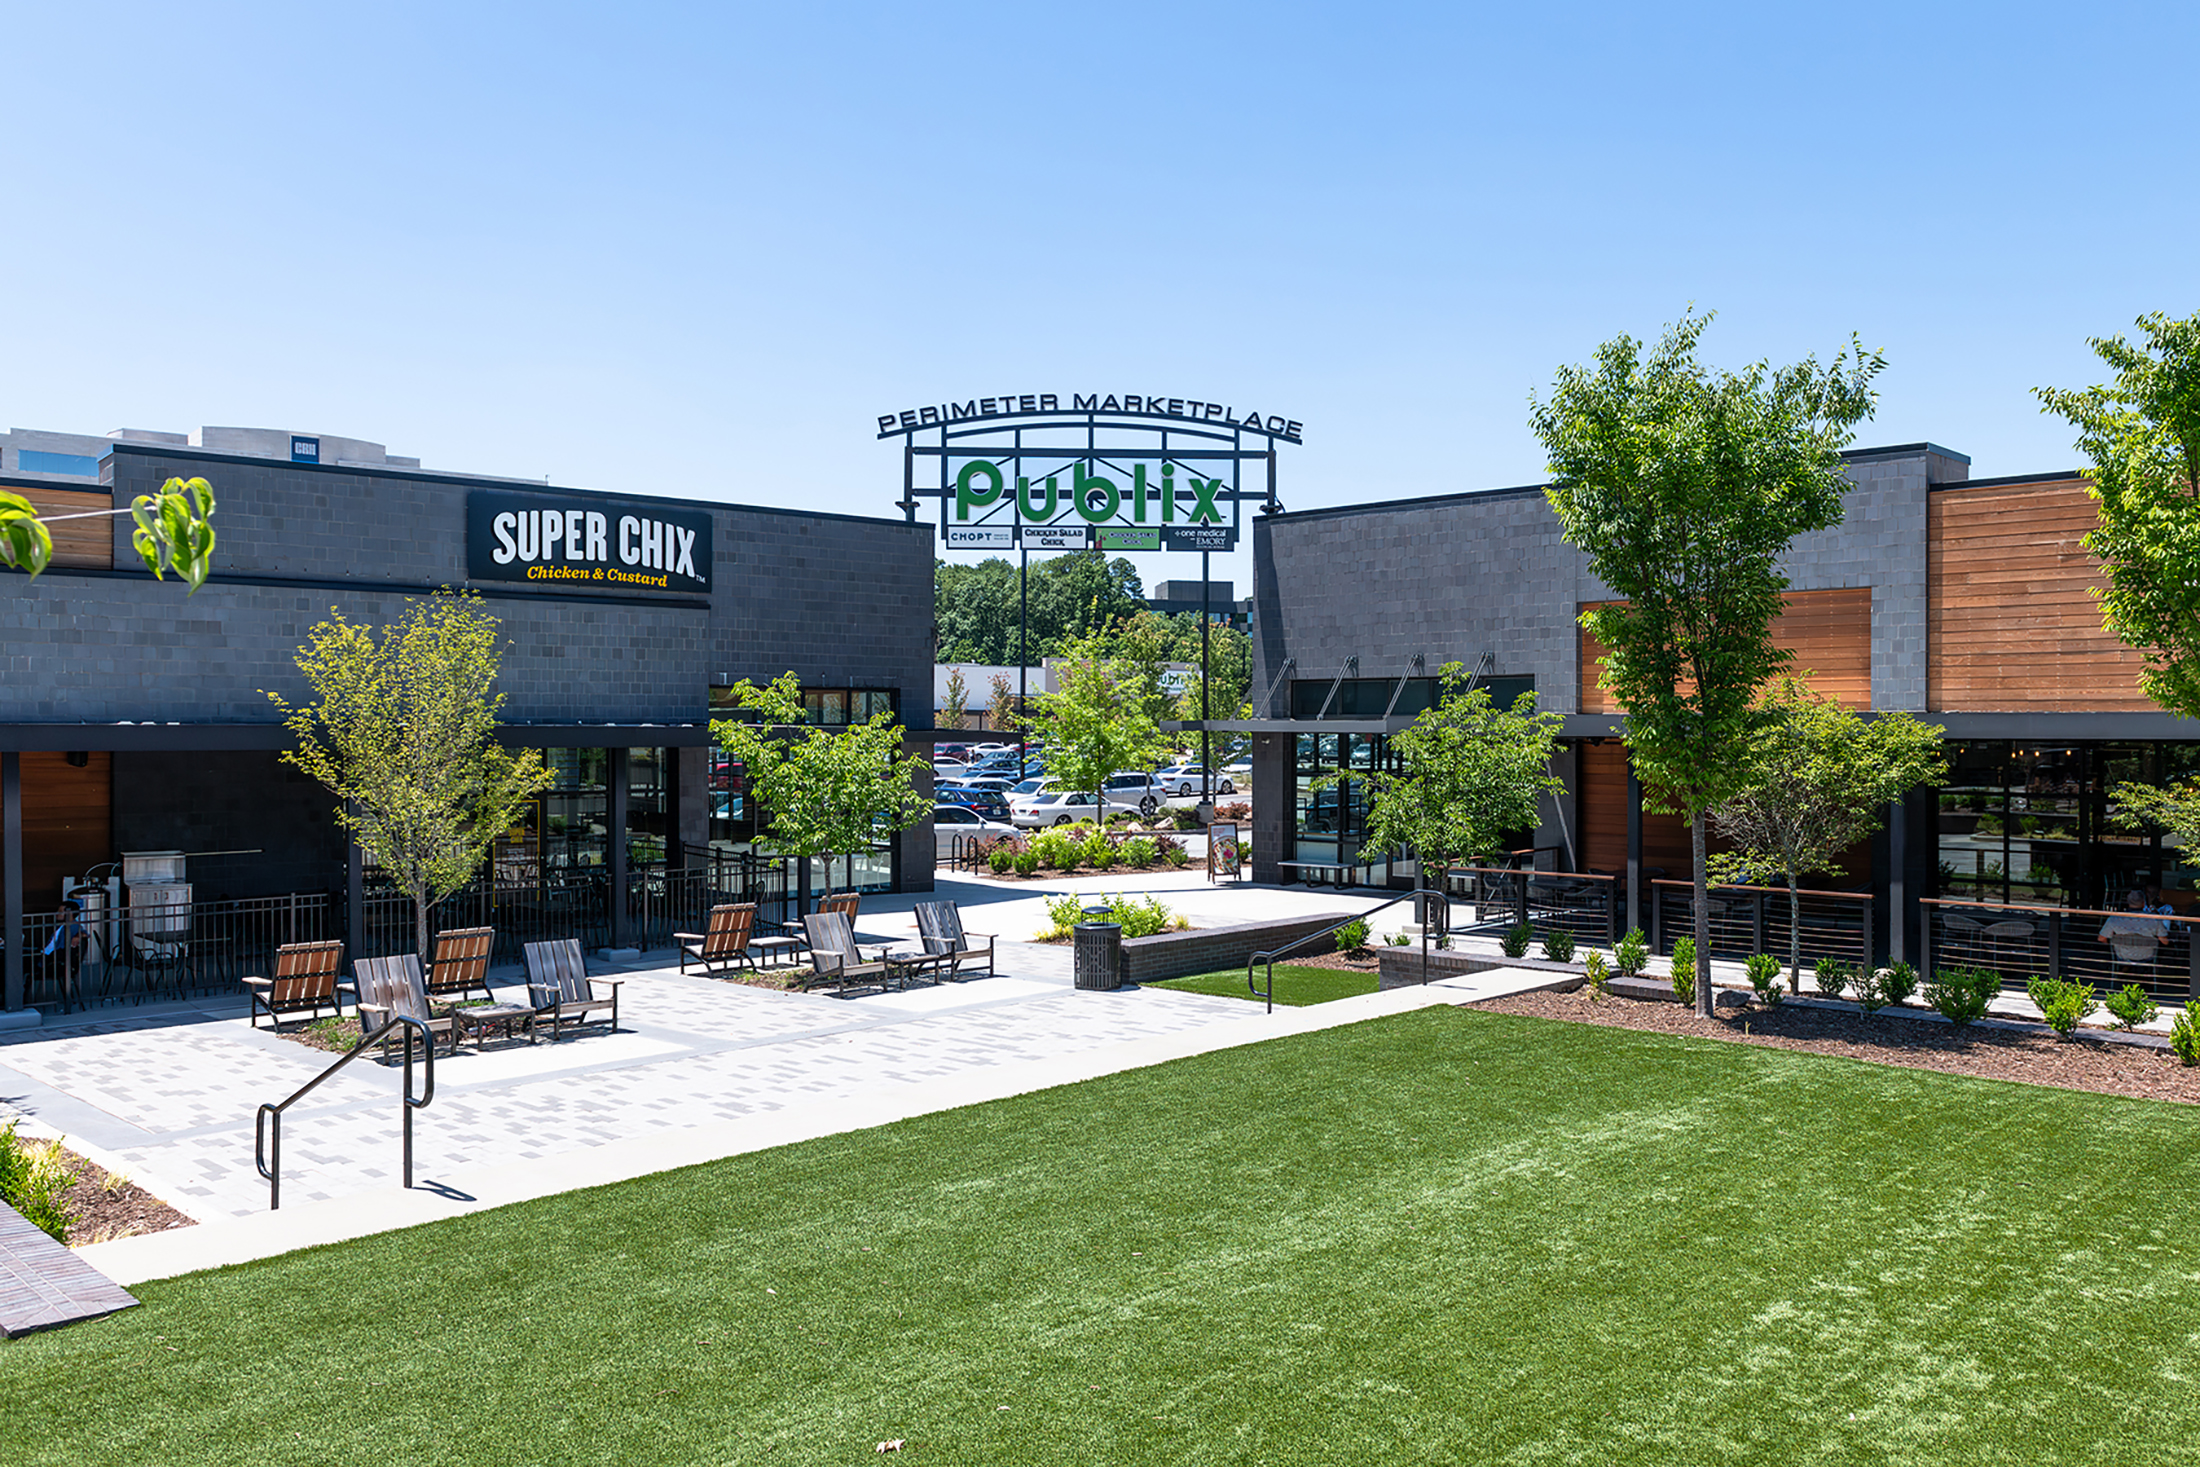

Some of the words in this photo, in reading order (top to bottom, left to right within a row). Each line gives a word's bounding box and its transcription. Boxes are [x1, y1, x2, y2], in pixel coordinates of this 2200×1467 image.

[877, 393, 1058, 432] PERIMETER
[1073, 393, 1303, 438] MARKETPLACE
[955, 460, 1224, 525] Publix
[951, 532, 992, 541] CHOPT
[1025, 528, 1058, 537] CHICKEN
[1059, 528, 1084, 537] SALAD
[1197, 529, 1227, 537] medical
[492, 510, 607, 565] SUPER
[619, 515, 696, 578] CHIX
[1041, 538, 1065, 546] CHICK
[1196, 537, 1226, 545] EMORY
[526, 565, 590, 579] Chicken
[592, 567, 604, 580] &
[606, 567, 668, 587] Custard
